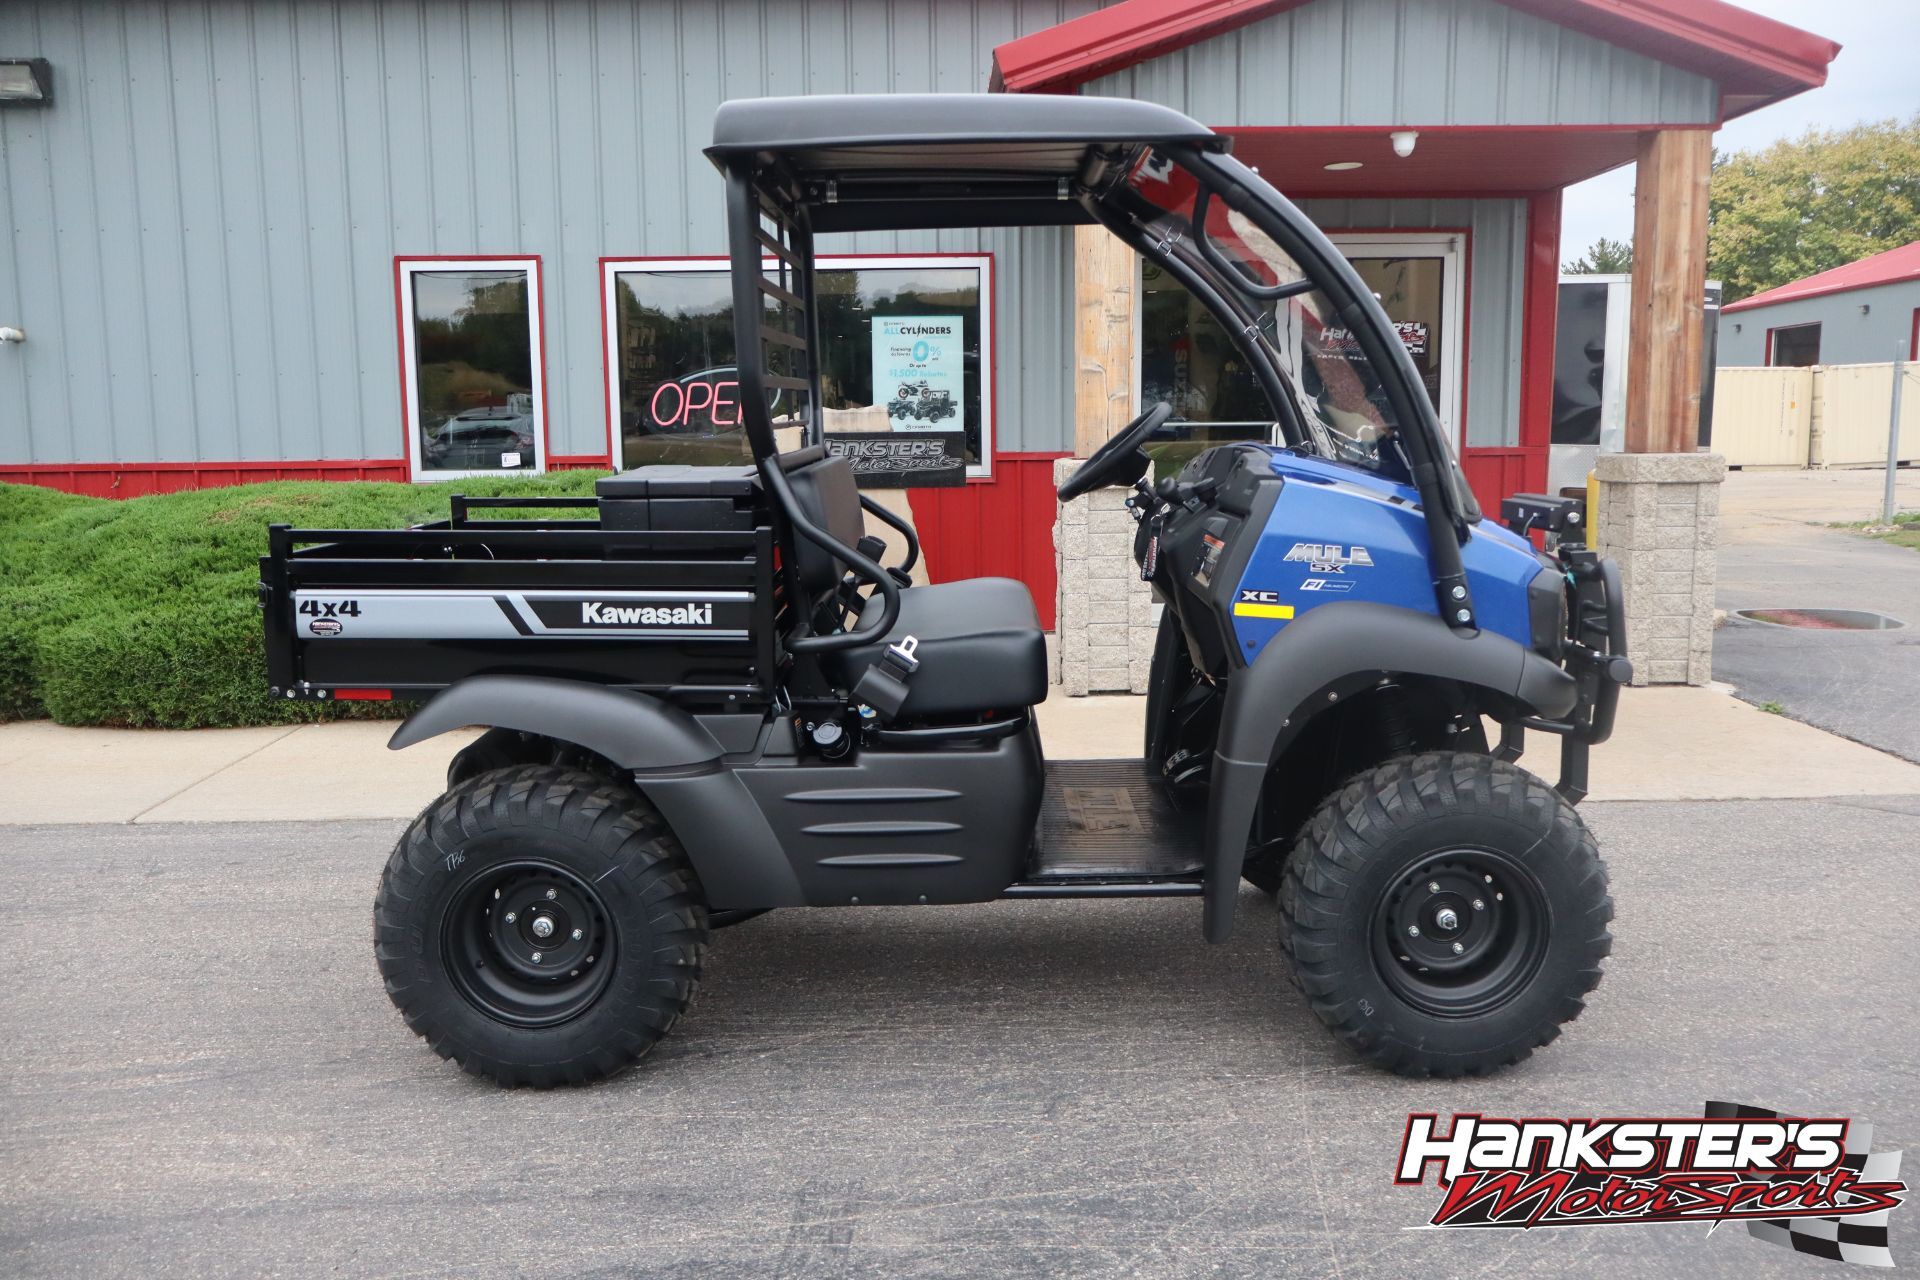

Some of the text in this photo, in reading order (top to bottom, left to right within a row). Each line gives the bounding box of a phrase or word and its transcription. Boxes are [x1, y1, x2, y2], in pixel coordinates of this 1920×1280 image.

[652, 382, 744, 426] OPE
[1283, 543, 1375, 567] MULE
[1310, 563, 1346, 574] SX
[1241, 590, 1278, 602] XC
[299, 600, 362, 617] 4x4
[582, 602, 712, 625] Kawasaki
